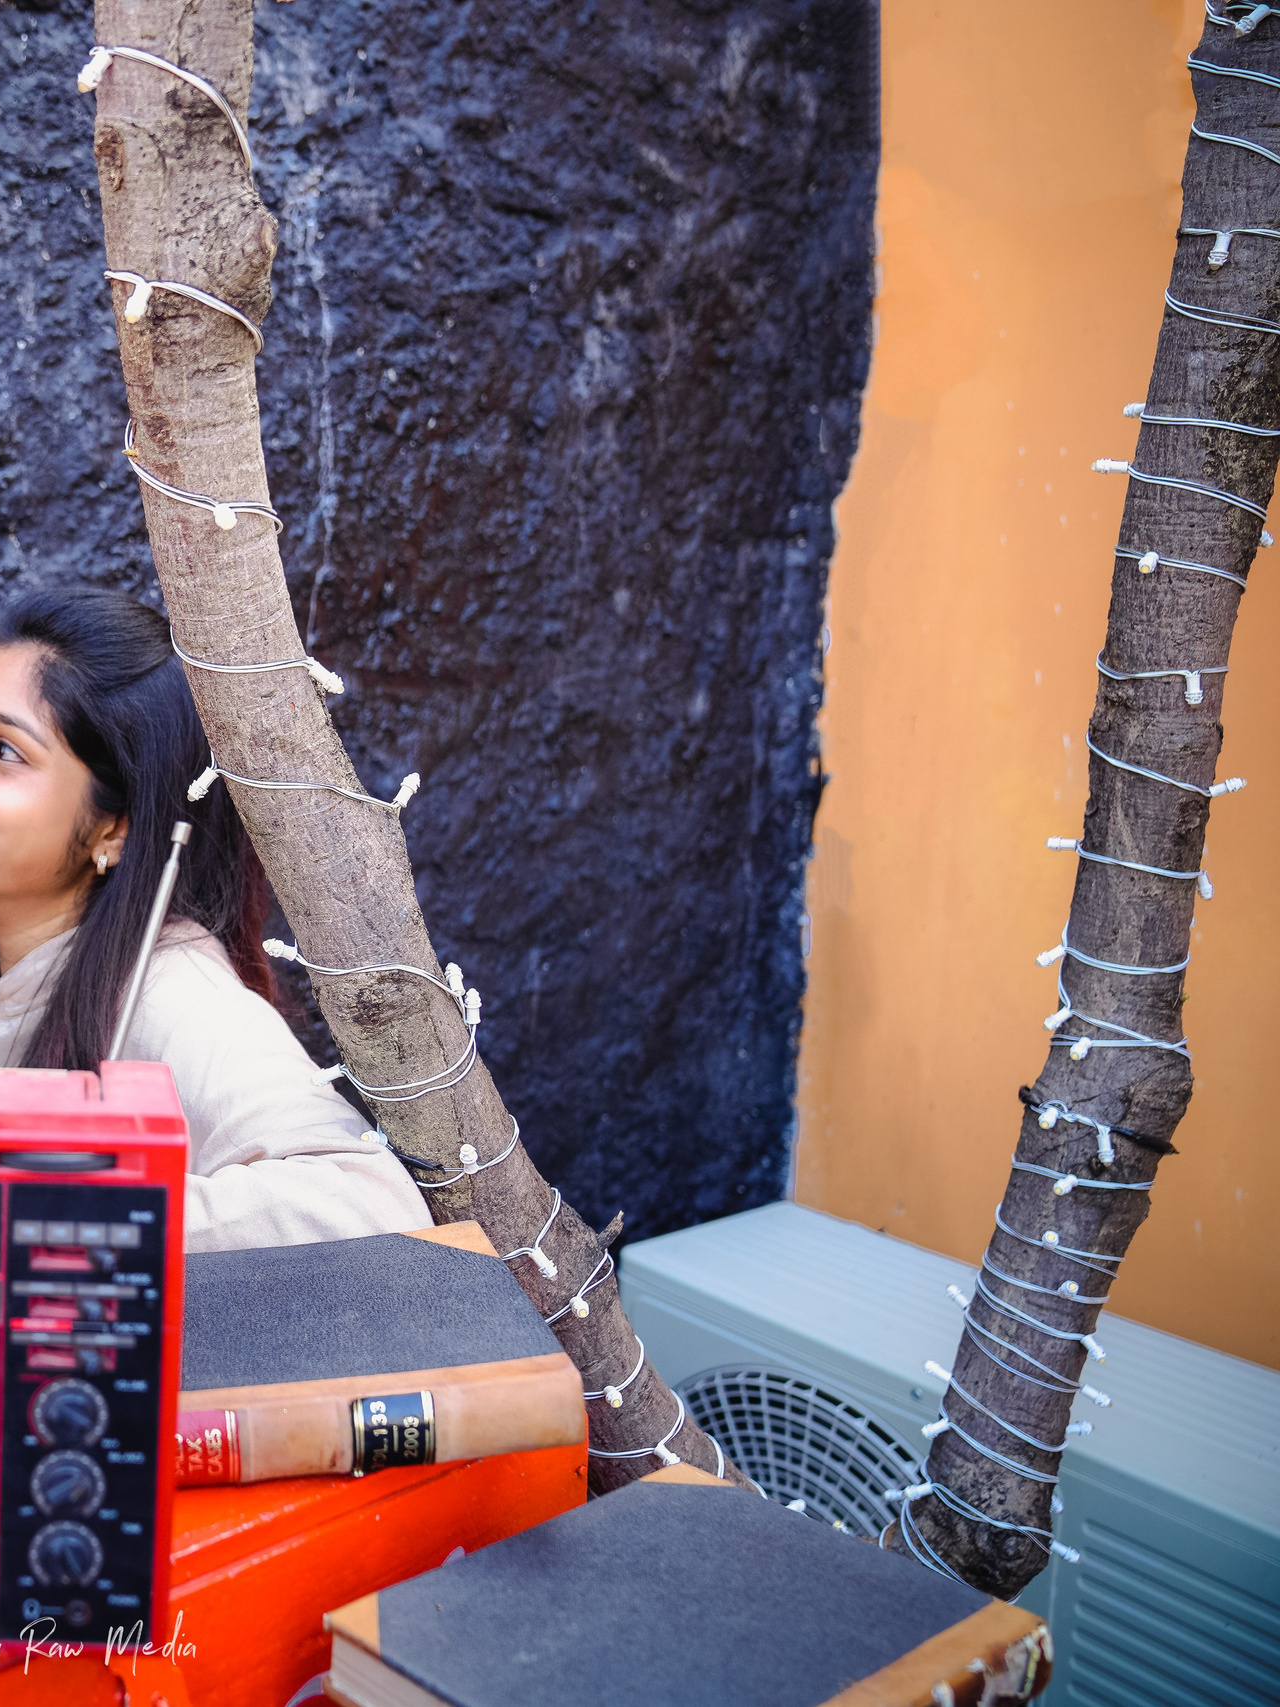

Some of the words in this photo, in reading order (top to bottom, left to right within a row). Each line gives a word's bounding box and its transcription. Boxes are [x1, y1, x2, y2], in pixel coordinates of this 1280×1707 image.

[186, 1437, 203, 1474] TAX
[205, 1428, 224, 1476] CASES
[403, 1415, 420, 1459] 2003
